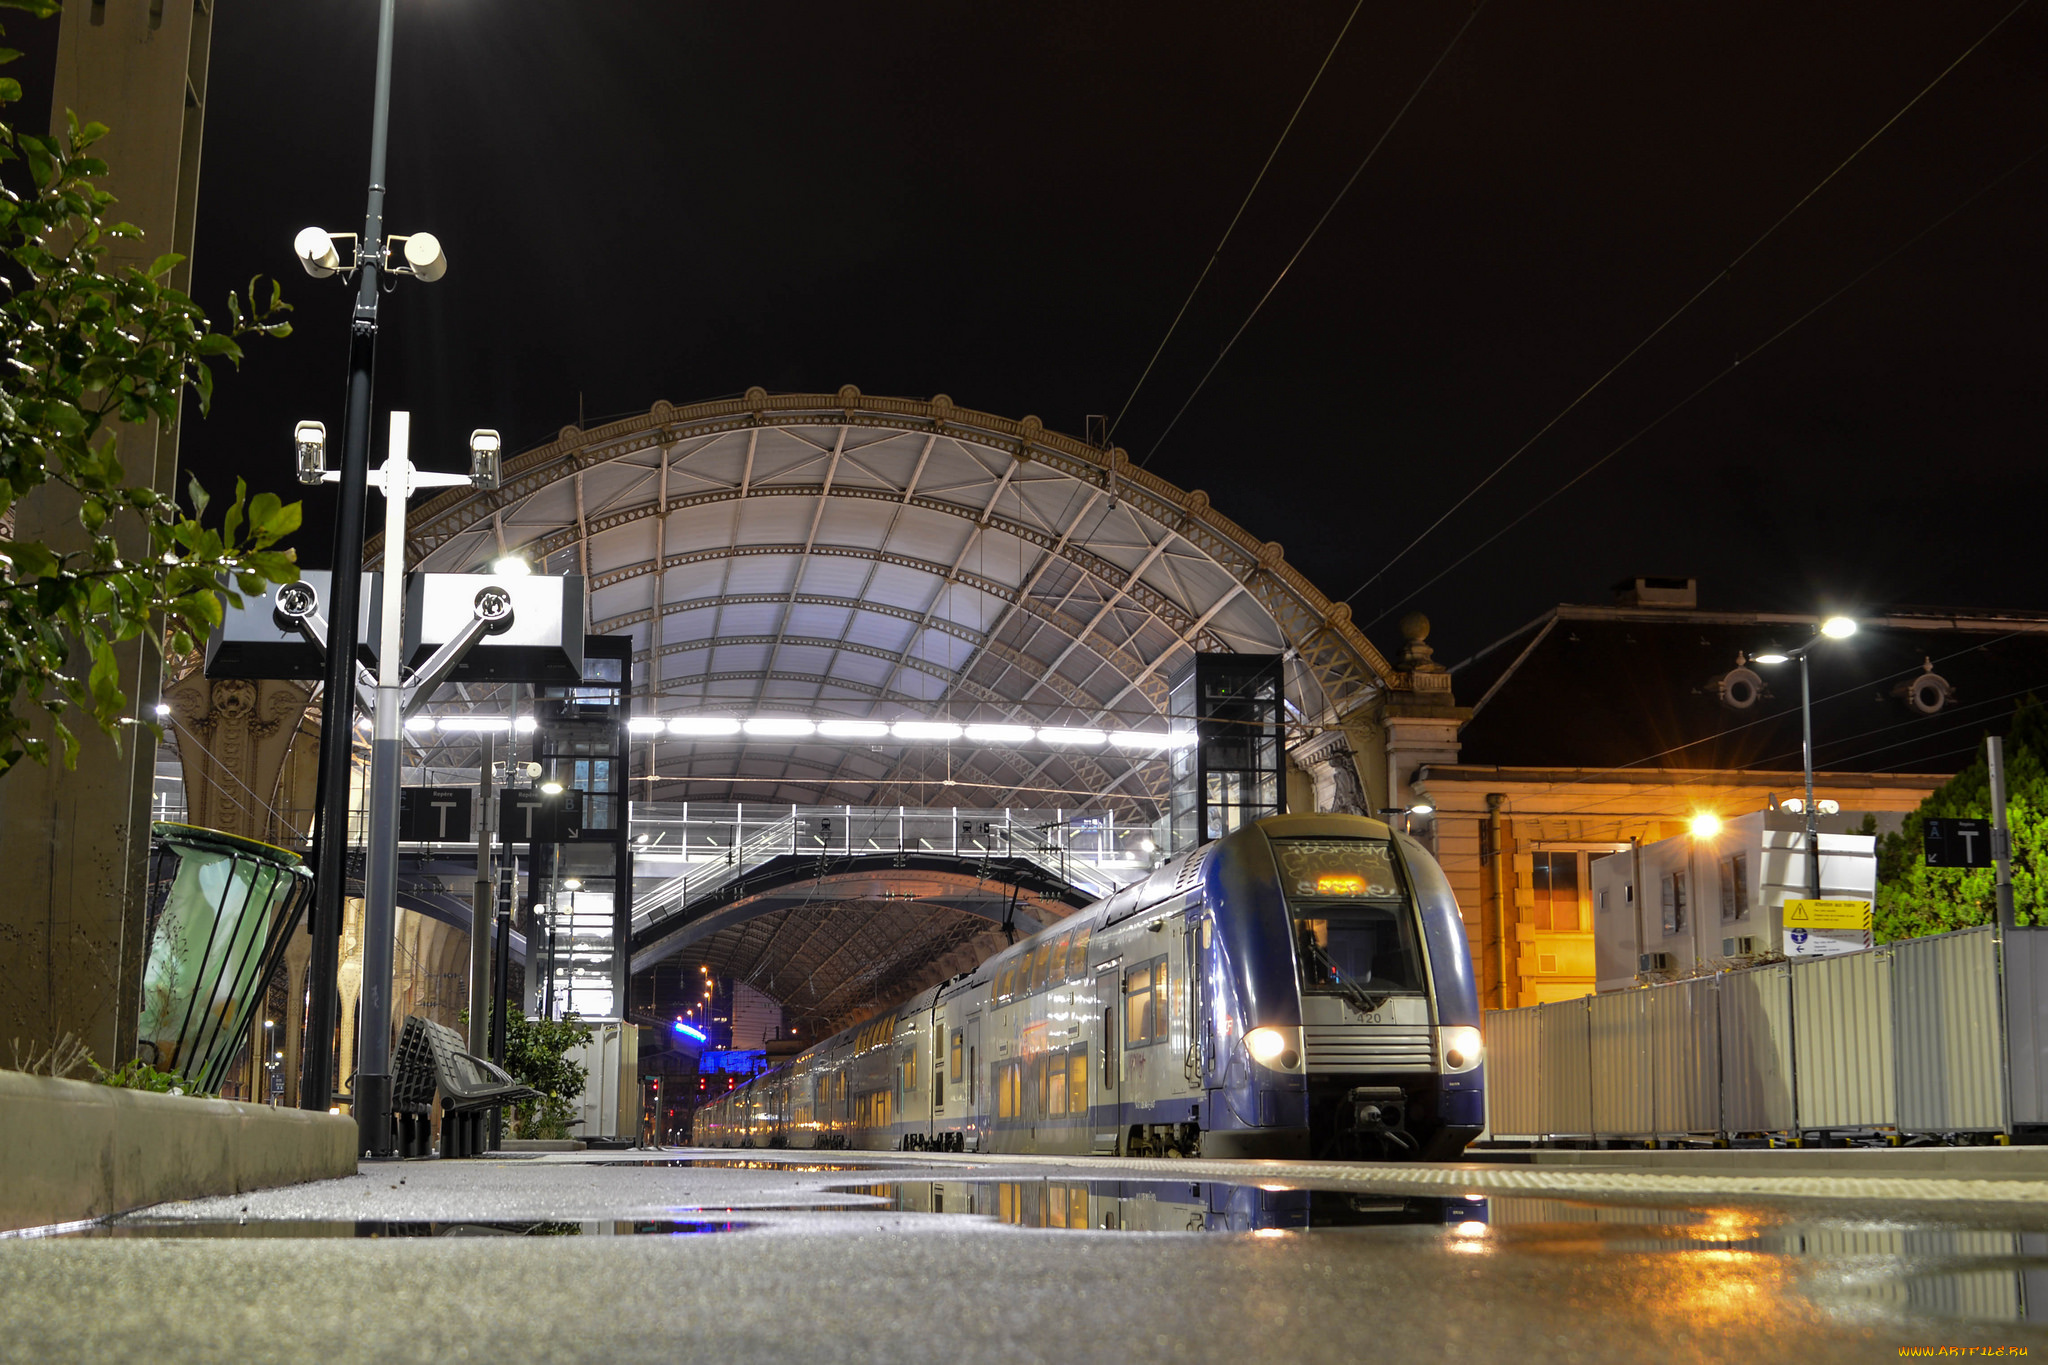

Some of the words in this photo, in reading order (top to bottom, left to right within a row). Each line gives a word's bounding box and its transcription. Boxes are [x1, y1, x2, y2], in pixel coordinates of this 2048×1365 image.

[433, 790, 453, 798] Repère
[565, 798, 575, 810] B
[431, 802, 457, 838] T
[517, 802, 543, 838] T
[1930, 826, 1940, 837] A
[1957, 830, 1979, 864] T
[1357, 1013, 1382, 1024] 420
